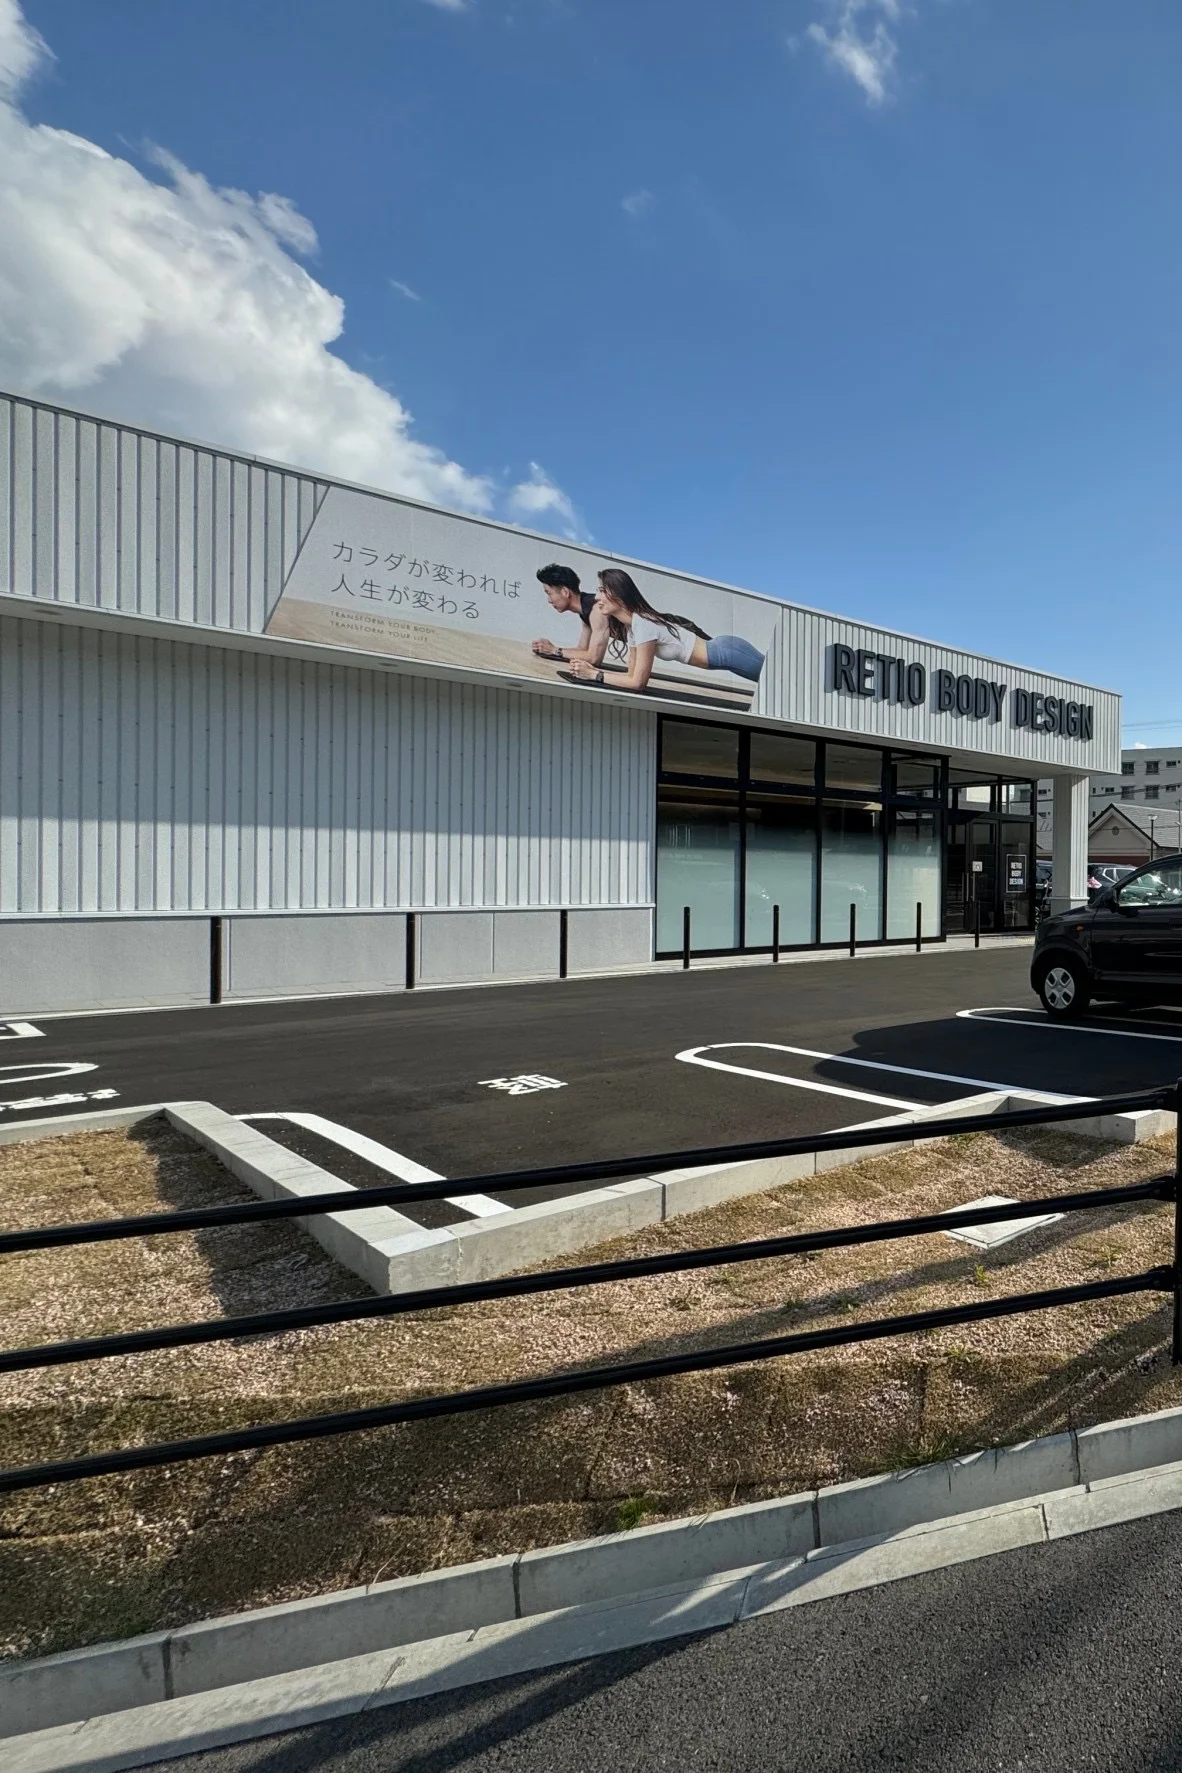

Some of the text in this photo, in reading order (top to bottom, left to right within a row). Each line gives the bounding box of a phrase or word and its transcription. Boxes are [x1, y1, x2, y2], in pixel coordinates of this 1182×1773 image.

[332, 541, 522, 598] カラダが変われば
[331, 573, 479, 619] 人生が変わる
[330, 610, 436, 635] TRANSFORM YOUR BODY
[330, 620, 429, 643] TRANSFORM YOUR LIFE
[833, 643, 1094, 740] RETIO BODY DESIGN
